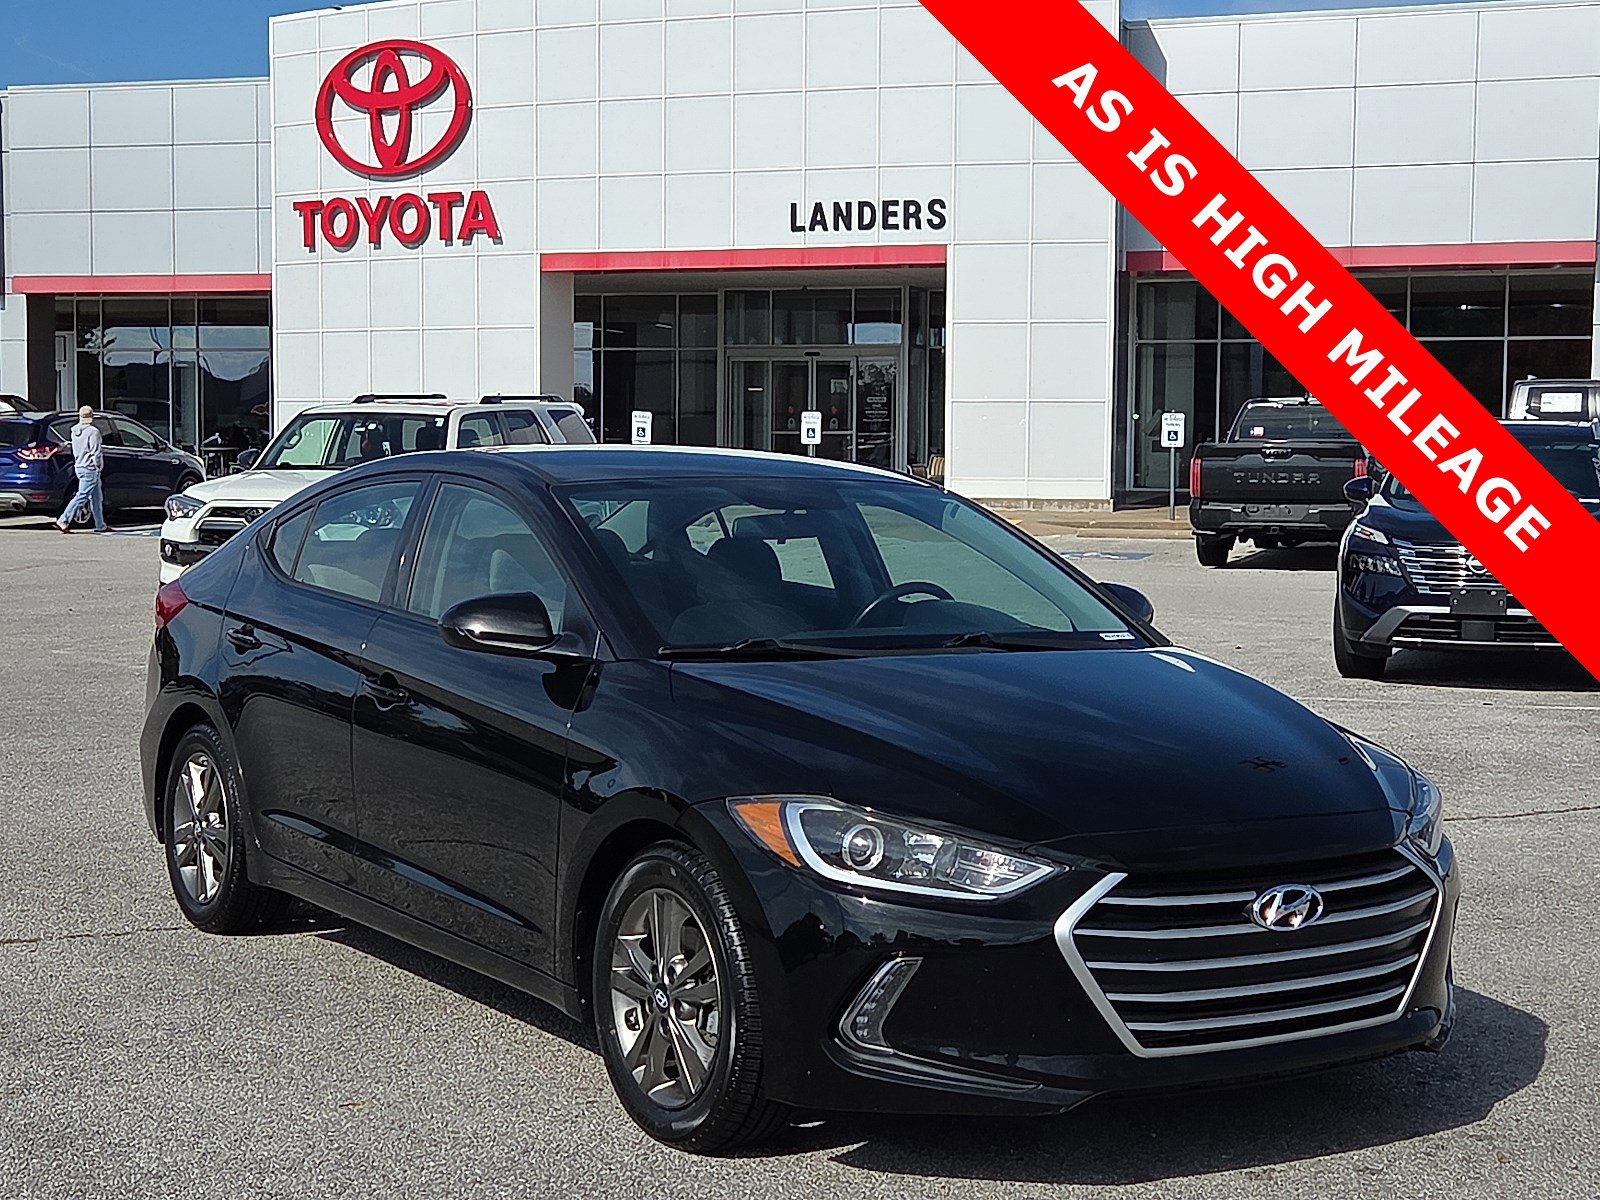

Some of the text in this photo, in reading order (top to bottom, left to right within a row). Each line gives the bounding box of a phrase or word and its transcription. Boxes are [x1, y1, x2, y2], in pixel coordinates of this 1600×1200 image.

[293, 191, 502, 251] TOYOTA
[791, 199, 947, 232] LANDERS
[1233, 472, 1321, 484] TUNDRA
